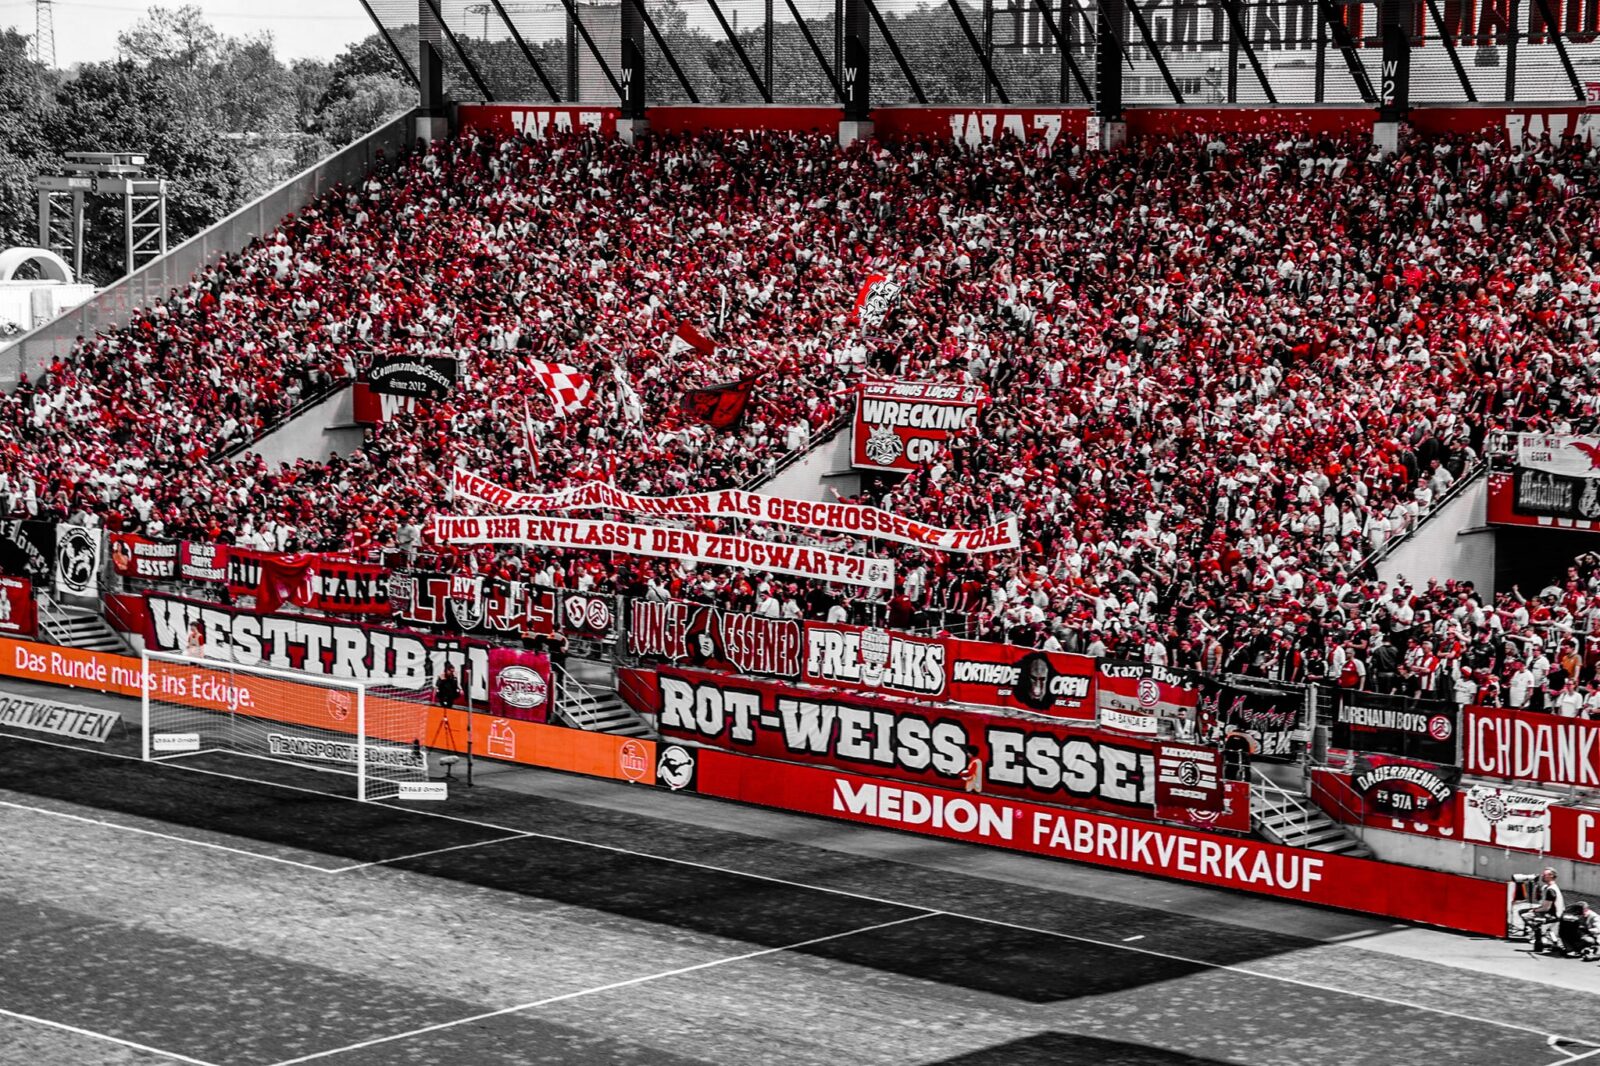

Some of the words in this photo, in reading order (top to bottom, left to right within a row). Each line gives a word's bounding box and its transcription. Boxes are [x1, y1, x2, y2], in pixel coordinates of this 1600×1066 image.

[621, 69, 632, 82] W
[845, 68, 857, 82] W
[1382, 61, 1398, 77] W
[623, 85, 630, 101] 1
[847, 85, 854, 101] 1
[1383, 81, 1395, 98] 2
[408, 381, 427, 391] 2012
[867, 385, 886, 394] LOS
[925, 386, 959, 399] LOCOS
[863, 400, 977, 429] WRECKING
[454, 470, 513, 507] MEHR
[717, 491, 761, 516] ALS
[951, 521, 1012, 549] TORE
[438, 518, 480, 540] UND
[486, 518, 521, 538] IHR
[527, 519, 648, 549] ENTLASST
[652, 529, 698, 556] DEN
[705, 538, 865, 580] ZEUGWART?!
[319, 569, 390, 604] FANS
[628, 598, 688, 658] JUNGE
[723, 612, 801, 676] ESSENER
[15, 646, 46, 673] Das
[51, 651, 107, 682] Runde
[111, 666, 157, 691] mus
[162, 668, 186, 696] ins
[192, 674, 255, 710] Eckige.
[808, 627, 945, 696] FREAKS
[953, 661, 1021, 686] NORTHSIDE
[1049, 675, 1090, 697] CREW
[660, 676, 967, 774] ROT-WEISS
[1338, 698, 1397, 728] ADRENALIN
[1396, 712, 1427, 732] BOYS
[1357, 765, 1451, 803] DAUERBRENNER
[833, 779, 1014, 841] MEDION
[1032, 812, 1324, 892] FABRIKVERKAUF
